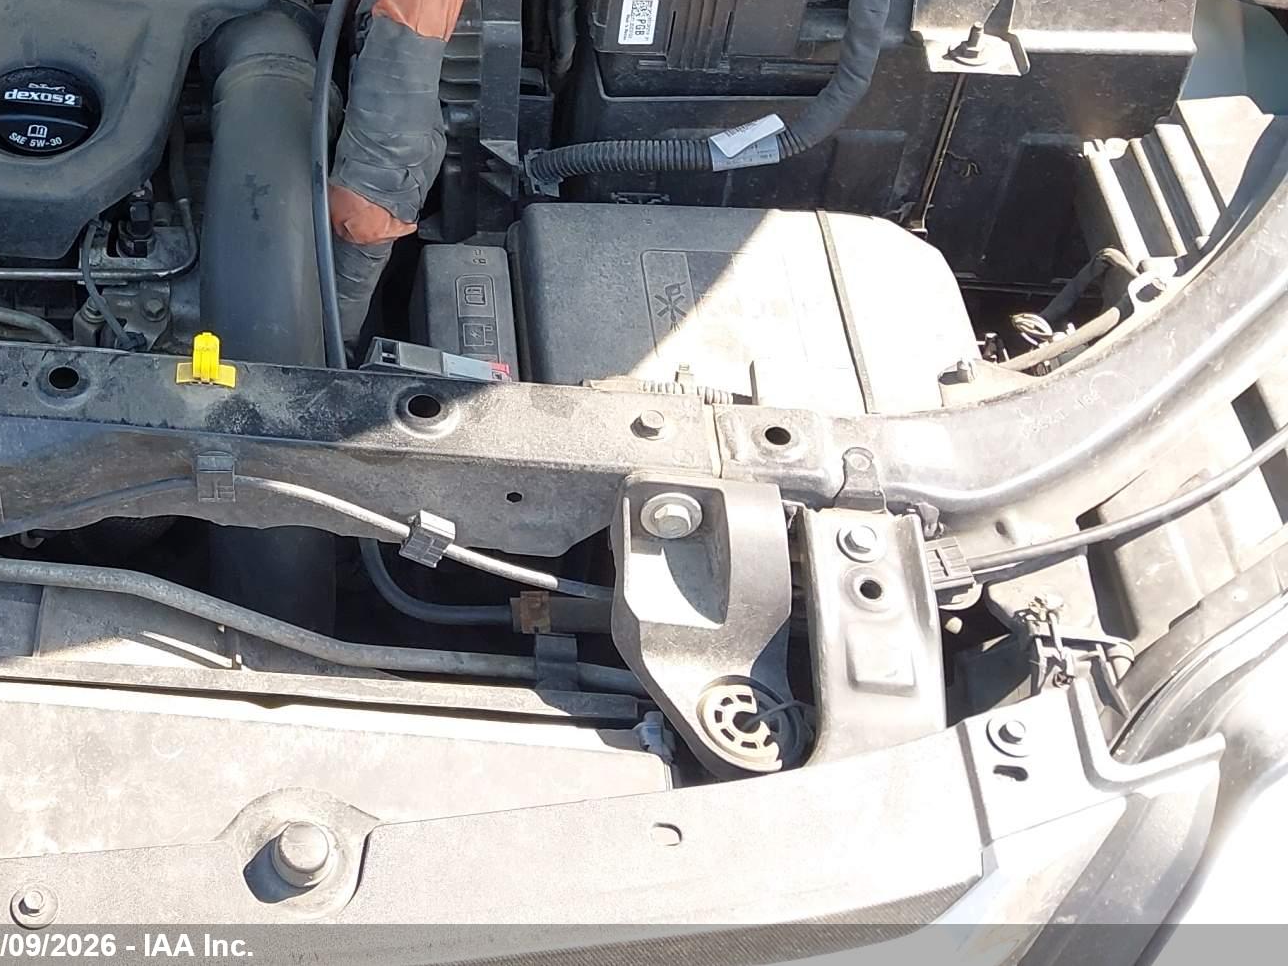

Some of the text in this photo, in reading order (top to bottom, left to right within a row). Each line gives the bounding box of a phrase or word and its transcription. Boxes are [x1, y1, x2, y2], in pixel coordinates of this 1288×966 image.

[634, 19, 647, 36] PGB
[4, 88, 77, 106] dexos2
[8, 132, 63, 148] SAE 5W-30
